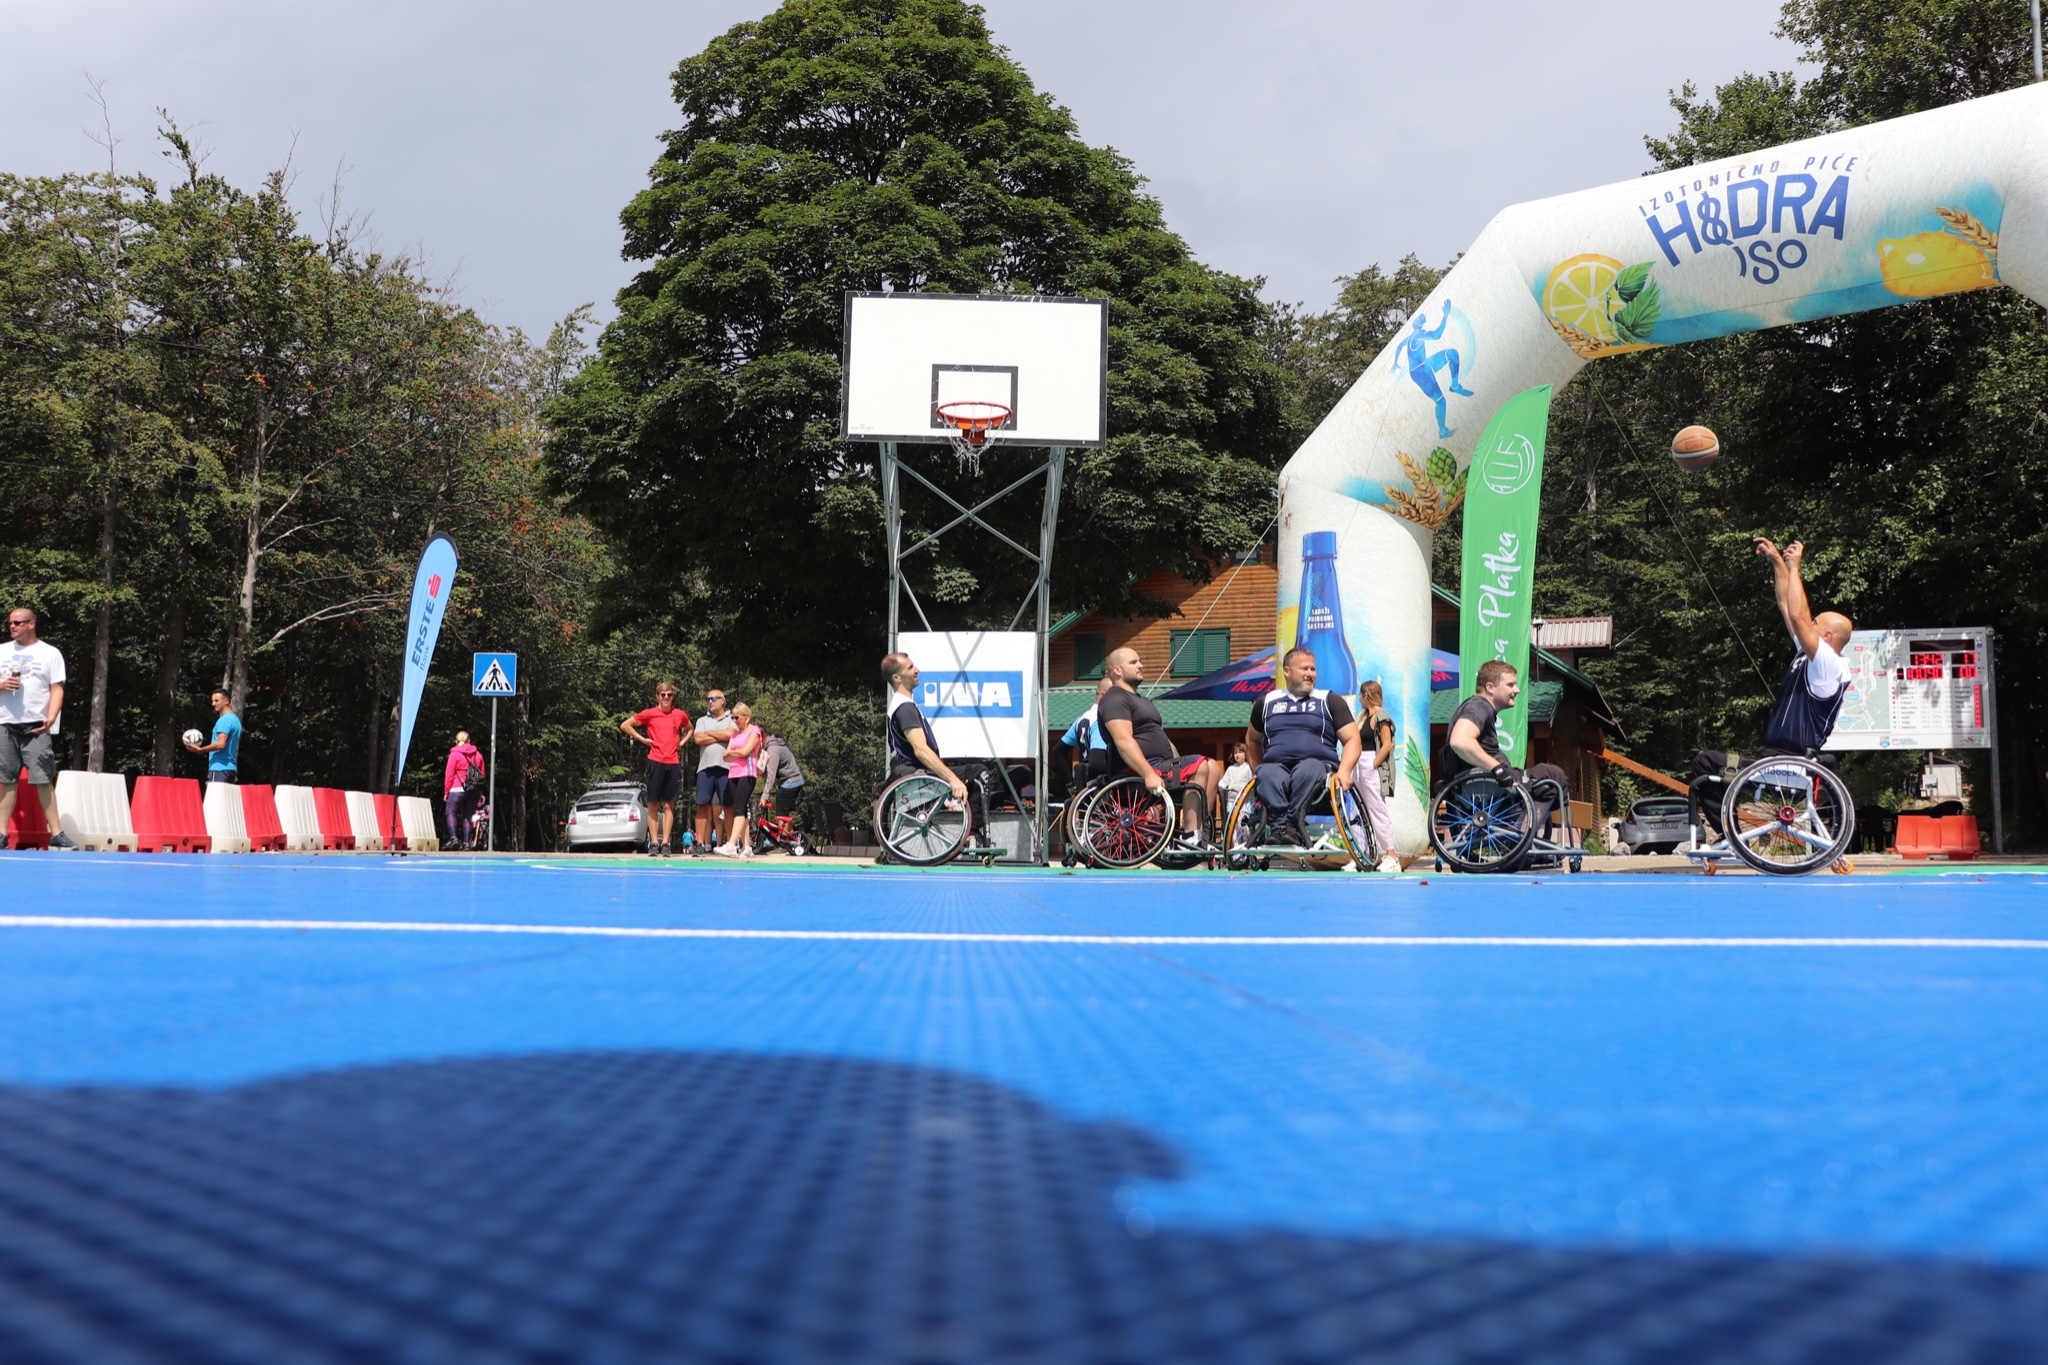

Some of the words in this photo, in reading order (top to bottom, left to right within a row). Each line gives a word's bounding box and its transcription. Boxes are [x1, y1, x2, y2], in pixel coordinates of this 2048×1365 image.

[1804, 153, 1858, 172] PIĆE
[1311, 606, 1330, 615] SADRŽI
[1308, 614, 1334, 623] PRIRODNE
[1308, 622, 1335, 630] SASTOJKE
[411, 599, 435, 667] ERSTE
[1301, 701, 1316, 713] 15
